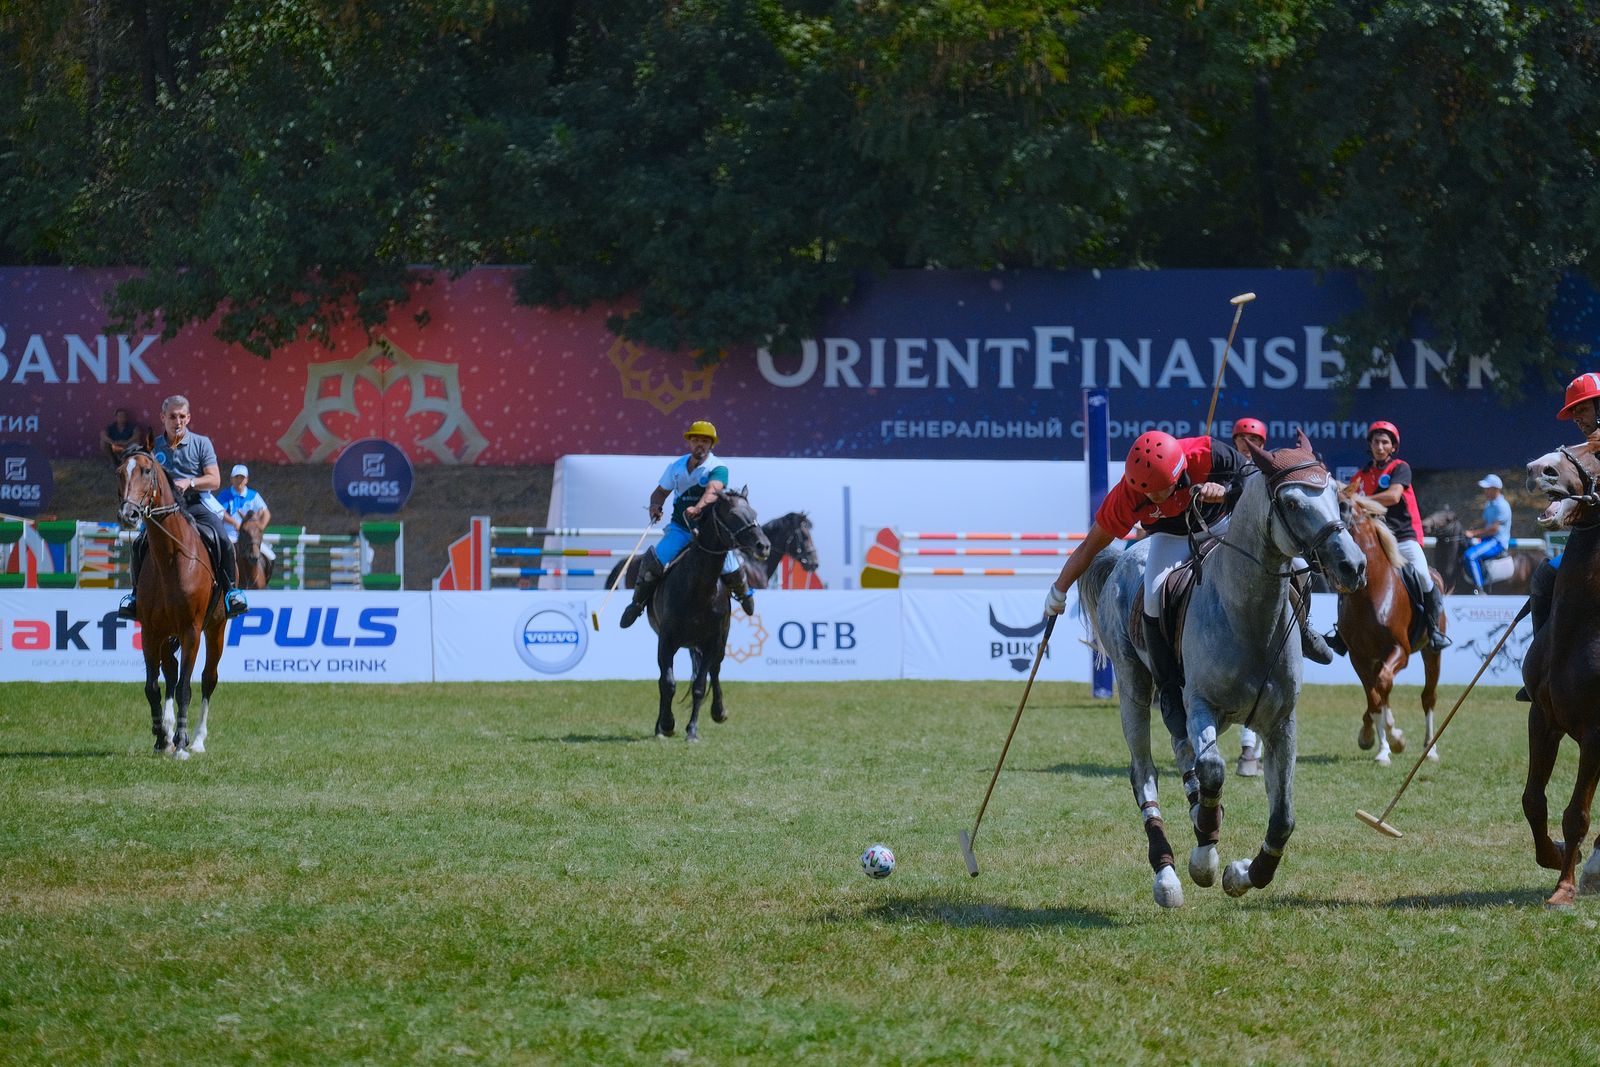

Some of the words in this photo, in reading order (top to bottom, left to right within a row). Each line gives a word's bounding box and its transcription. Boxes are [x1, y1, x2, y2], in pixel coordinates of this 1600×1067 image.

[0, 325, 160, 384] ANK
[880, 418, 1063, 439] ГЕНЕРАЛЬНЫЙ
[1070, 420, 1191, 439] СОНСОР
[347, 480, 400, 497] GROSS
[226, 607, 400, 647] PULS
[525, 631, 578, 643] VOLVO
[778, 621, 856, 650] OFB
[244, 658, 321, 672] ENERGY
[327, 658, 387, 672] DRINK
